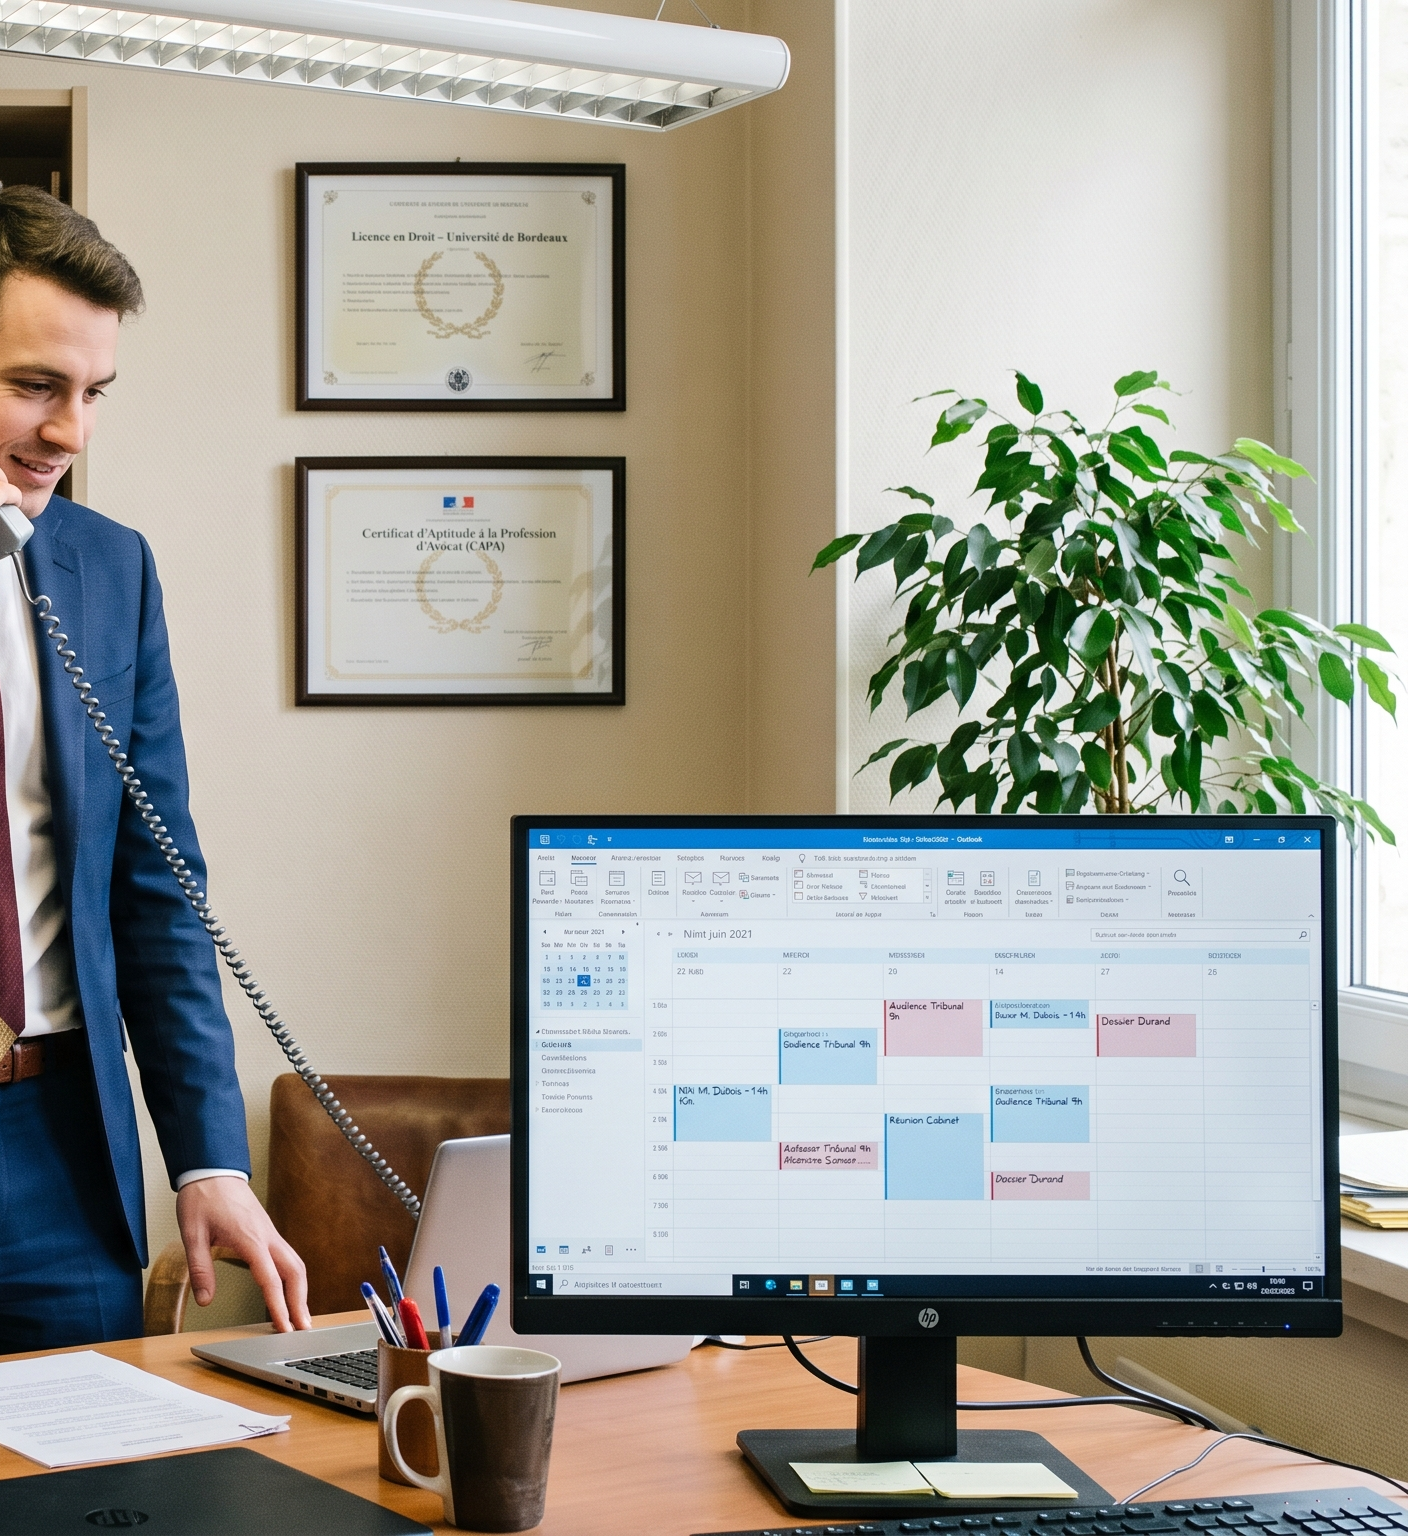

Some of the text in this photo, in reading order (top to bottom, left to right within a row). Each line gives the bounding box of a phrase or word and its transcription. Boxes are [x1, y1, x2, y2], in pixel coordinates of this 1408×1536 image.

[351, 232, 391, 241] Licence
[408, 232, 435, 242] Droit
[447, 231, 500, 242] Université
[502, 232, 514, 242] de
[517, 232, 568, 243] Bordeaux
[362, 528, 414, 539] Certificat
[488, 528, 498, 539] la
[500, 528, 556, 539] Profession
[465, 541, 505, 553] (CAPA)
[708, 930, 726, 940] juin
[730, 930, 752, 938] 2021
[931, 1002, 964, 1010] Tribunal
[1138, 1017, 1171, 1025] Durand
[926, 1116, 959, 1125] Cabinet
[1029, 1174, 1064, 1183] Durand
[921, 1308, 937, 1328] hp
